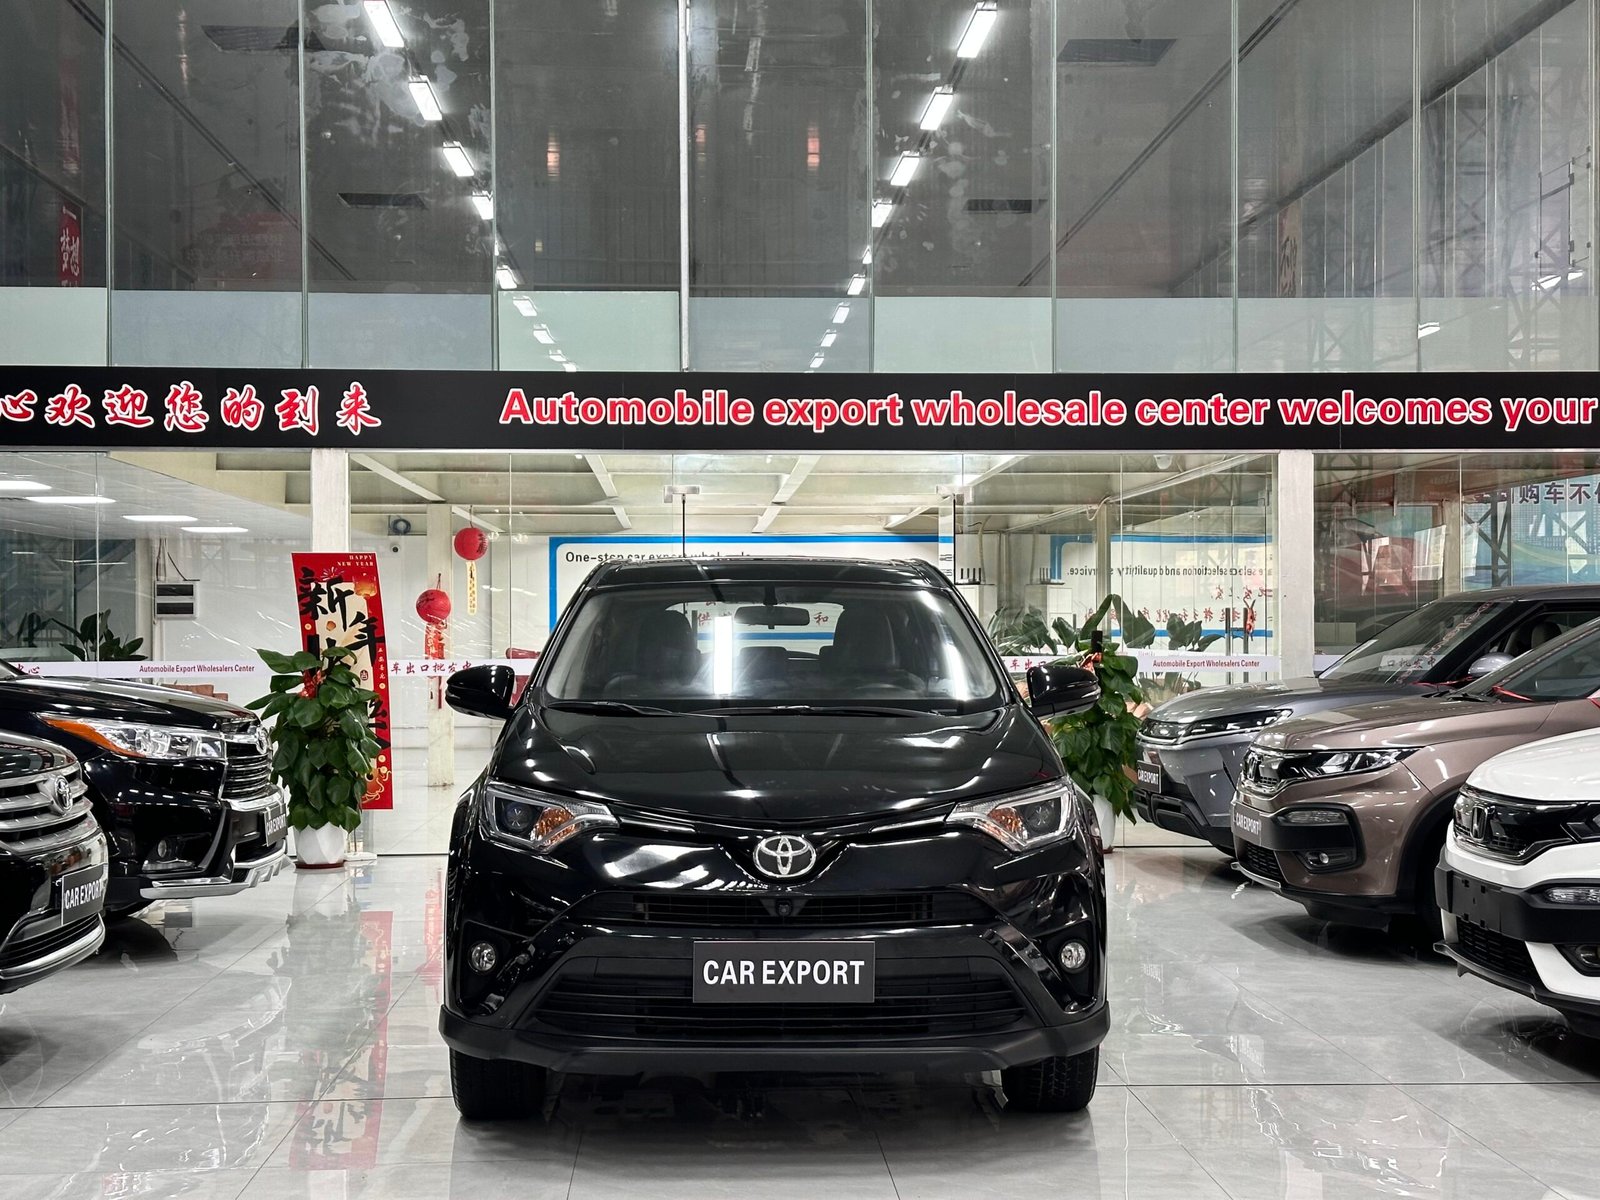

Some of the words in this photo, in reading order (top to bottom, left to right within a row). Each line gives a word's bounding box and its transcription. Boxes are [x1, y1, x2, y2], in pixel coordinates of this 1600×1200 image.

[0, 381, 381, 435] 心欢迎您的到来
[499, 388, 754, 425] Automobile
[762, 392, 903, 432] export
[911, 391, 1127, 426] wholesale
[1135, 393, 1270, 426] center
[1278, 390, 1493, 425] welcomes
[1500, 397, 1599, 431] your
[139, 665, 175, 673] Automobile
[176, 665, 196, 674] Export
[197, 664, 234, 672] Wholesalers
[234, 664, 255, 672] Center
[1186, 660, 1205, 668] Export
[1243, 815, 1259, 835] EXPORT
[65, 887, 80, 910] CAR
[703, 960, 755, 985] CAR
[762, 960, 865, 985] EXPORT
